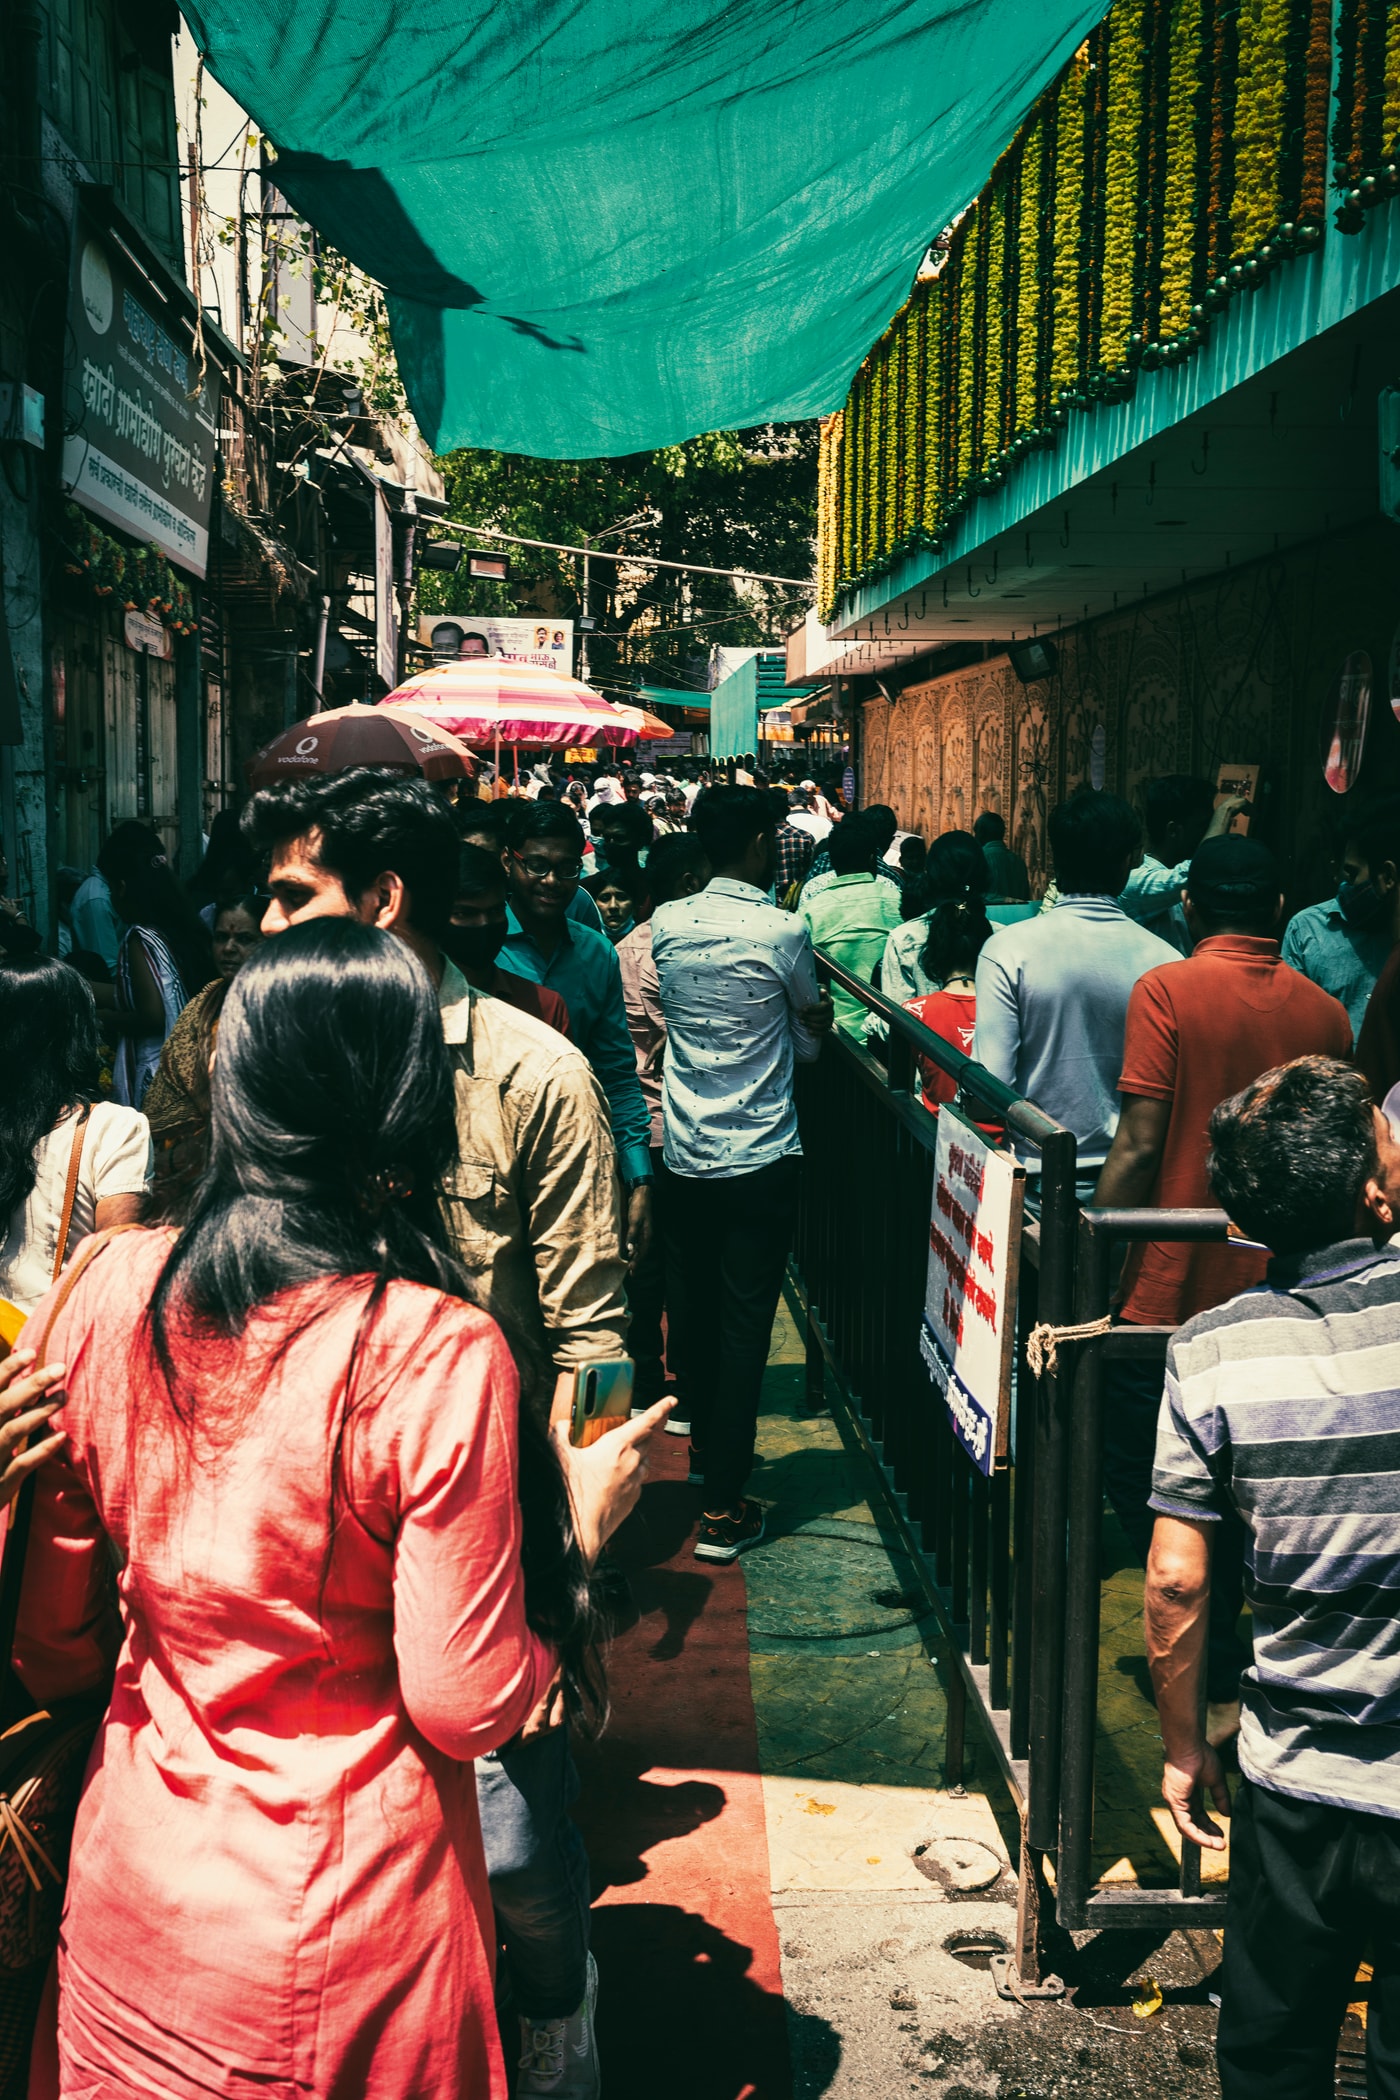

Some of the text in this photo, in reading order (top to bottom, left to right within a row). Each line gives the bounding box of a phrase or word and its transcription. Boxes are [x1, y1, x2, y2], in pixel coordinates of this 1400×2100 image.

[82, 357, 115, 427] खादी
[116, 385, 161, 467] ग्रामोद्योग
[162, 431, 190, 492] पुरवठा
[277, 755, 319, 765] vodafone
